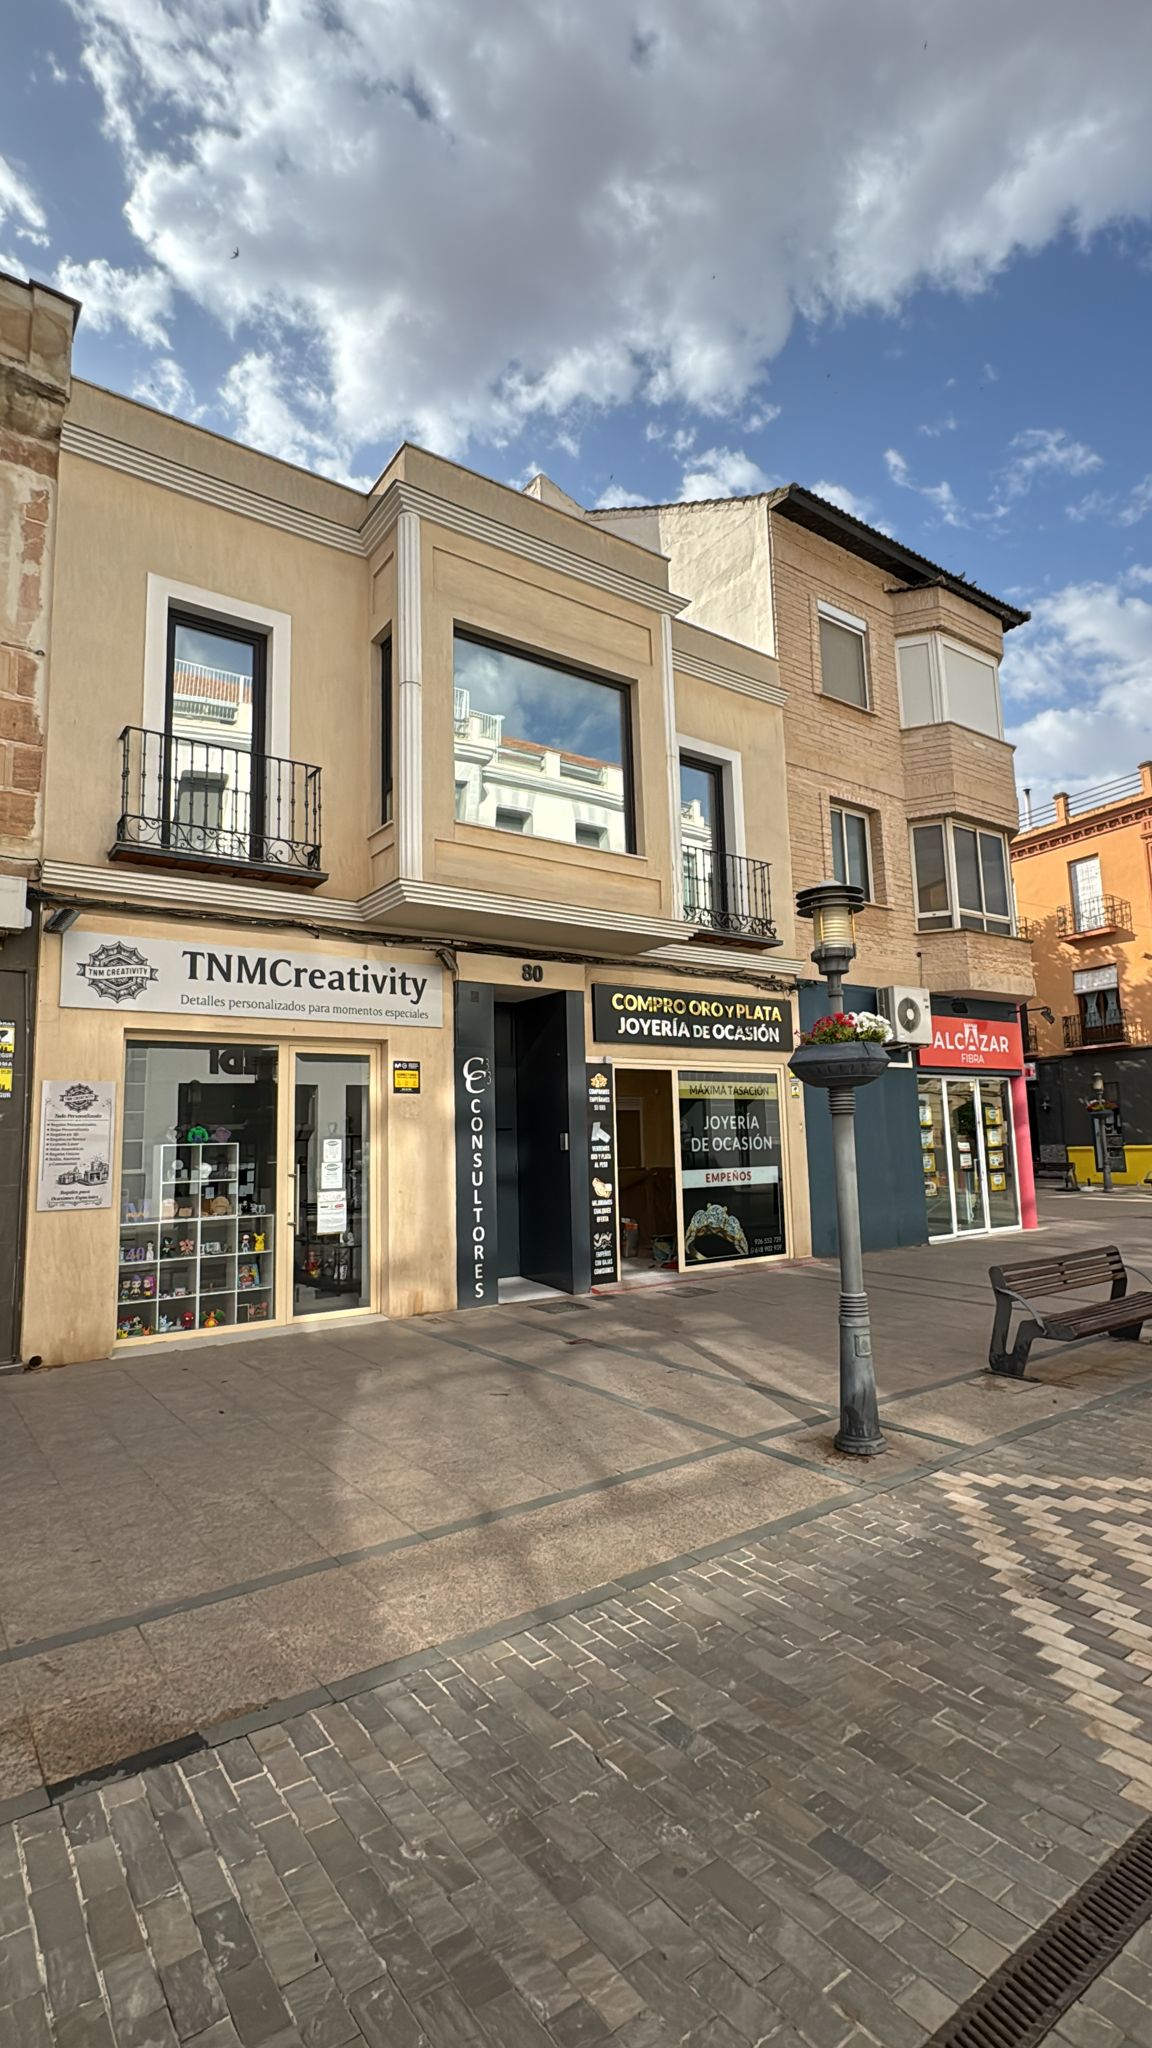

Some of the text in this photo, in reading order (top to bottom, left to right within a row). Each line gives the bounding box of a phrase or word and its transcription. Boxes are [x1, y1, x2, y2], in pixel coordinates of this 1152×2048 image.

[88, 967, 148, 977] TNM CREATIVITY
[182, 950, 428, 1005] TNMCreativity
[521, 964, 543, 983] 80
[180, 994, 429, 1020] Detalles personalizados para momentos especiales
[611, 992, 782, 1022] COMPRO ORO Y PLATA
[618, 1017, 780, 1043] JOYERÍA DE OCASIÓN
[961, 1053, 985, 1064] FIBRA
[689, 1083, 770, 1096] MÁXIMA TASACIÓN
[703, 1112, 760, 1130] JOYERÍA
[691, 1133, 773, 1152] DE OCASIÓN
[705, 1170, 752, 1184] EMPEÑOS
[470, 1098, 486, 1299] CONSULTORES
